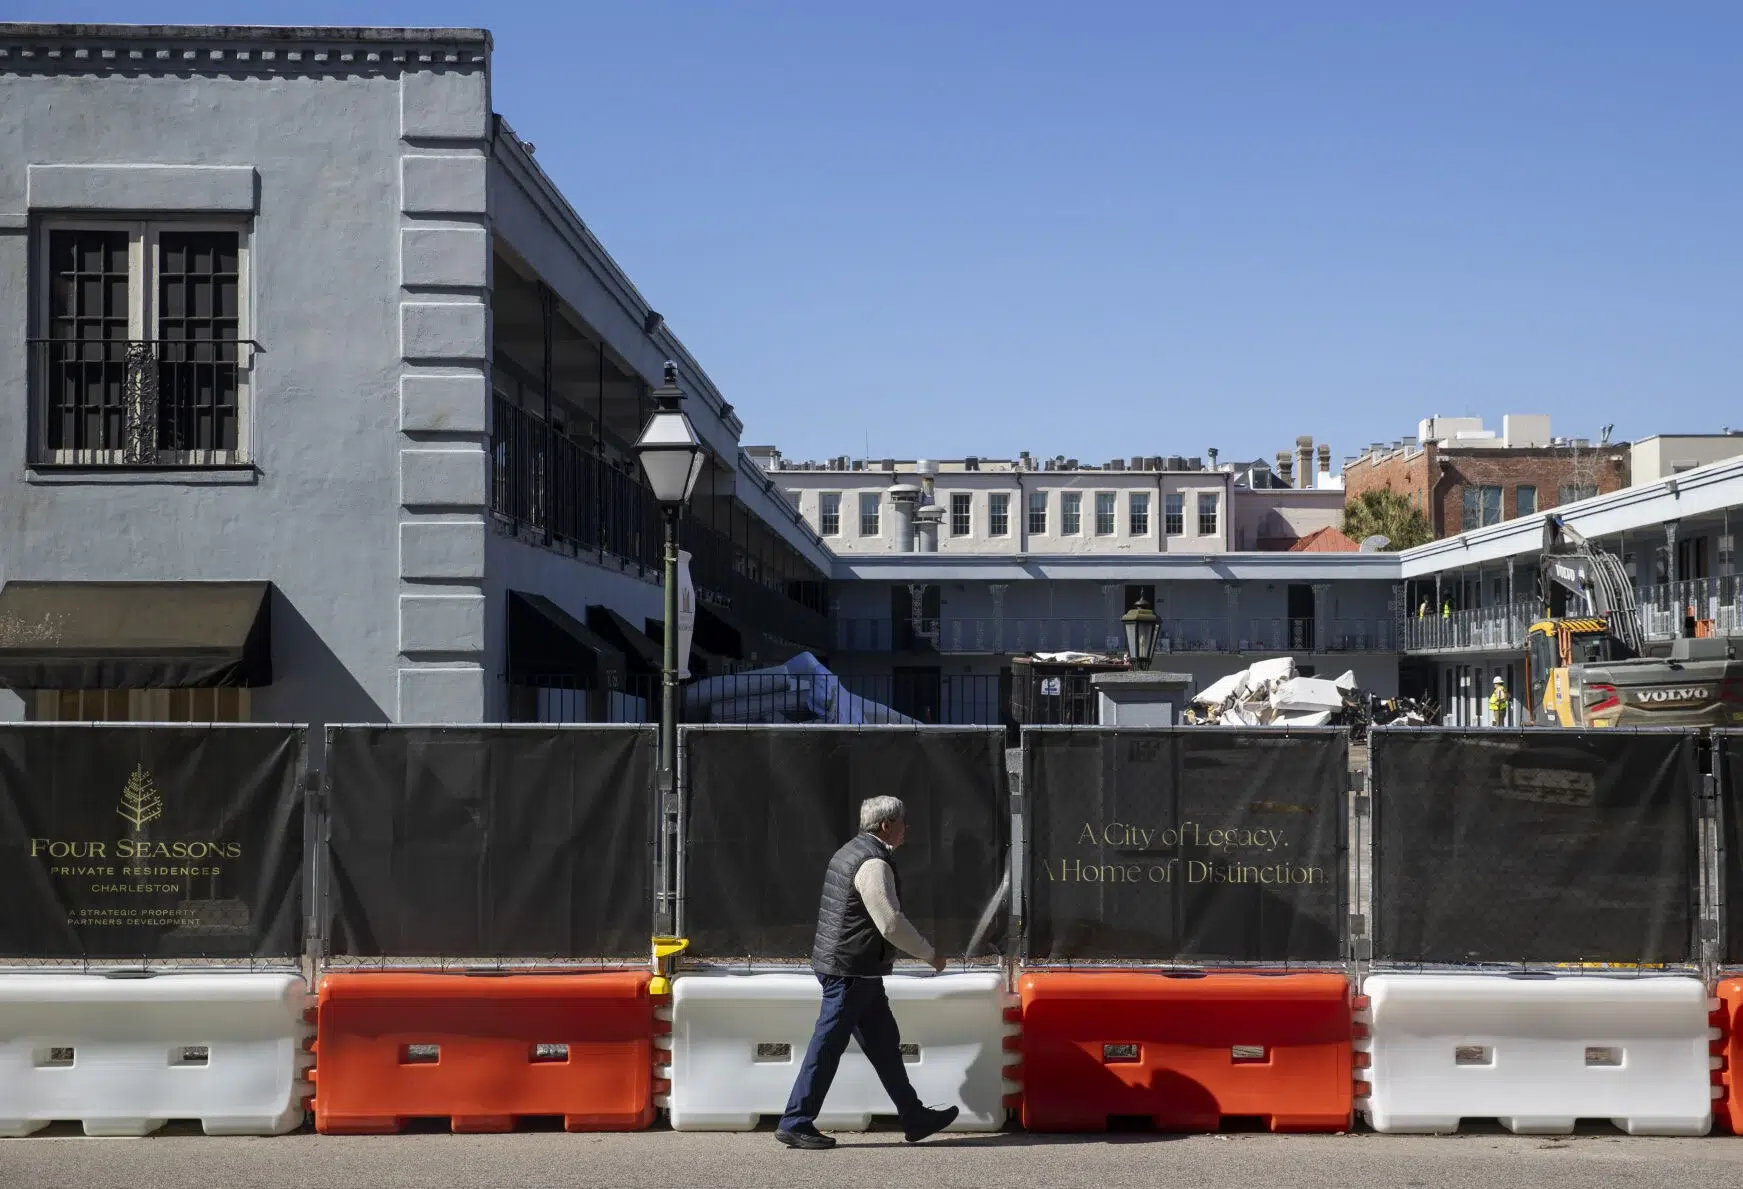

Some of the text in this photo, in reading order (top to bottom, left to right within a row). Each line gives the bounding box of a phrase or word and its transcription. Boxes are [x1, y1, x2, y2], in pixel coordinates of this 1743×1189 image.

[1636, 687, 1709, 702] VOLVO
[1078, 821, 1288, 853] A City of Legacy.
[30, 837, 241, 858] FOUR SEASONS
[51, 867, 221, 876] PRIVATE RESIDENCES
[1061, 859, 1141, 882] Home
[1148, 858, 1179, 882] of
[1188, 860, 1329, 884] Distinction.
[91, 884, 180, 893] CHARLESTON
[67, 918, 201, 926] PARTNERS DEVELOPMENT
